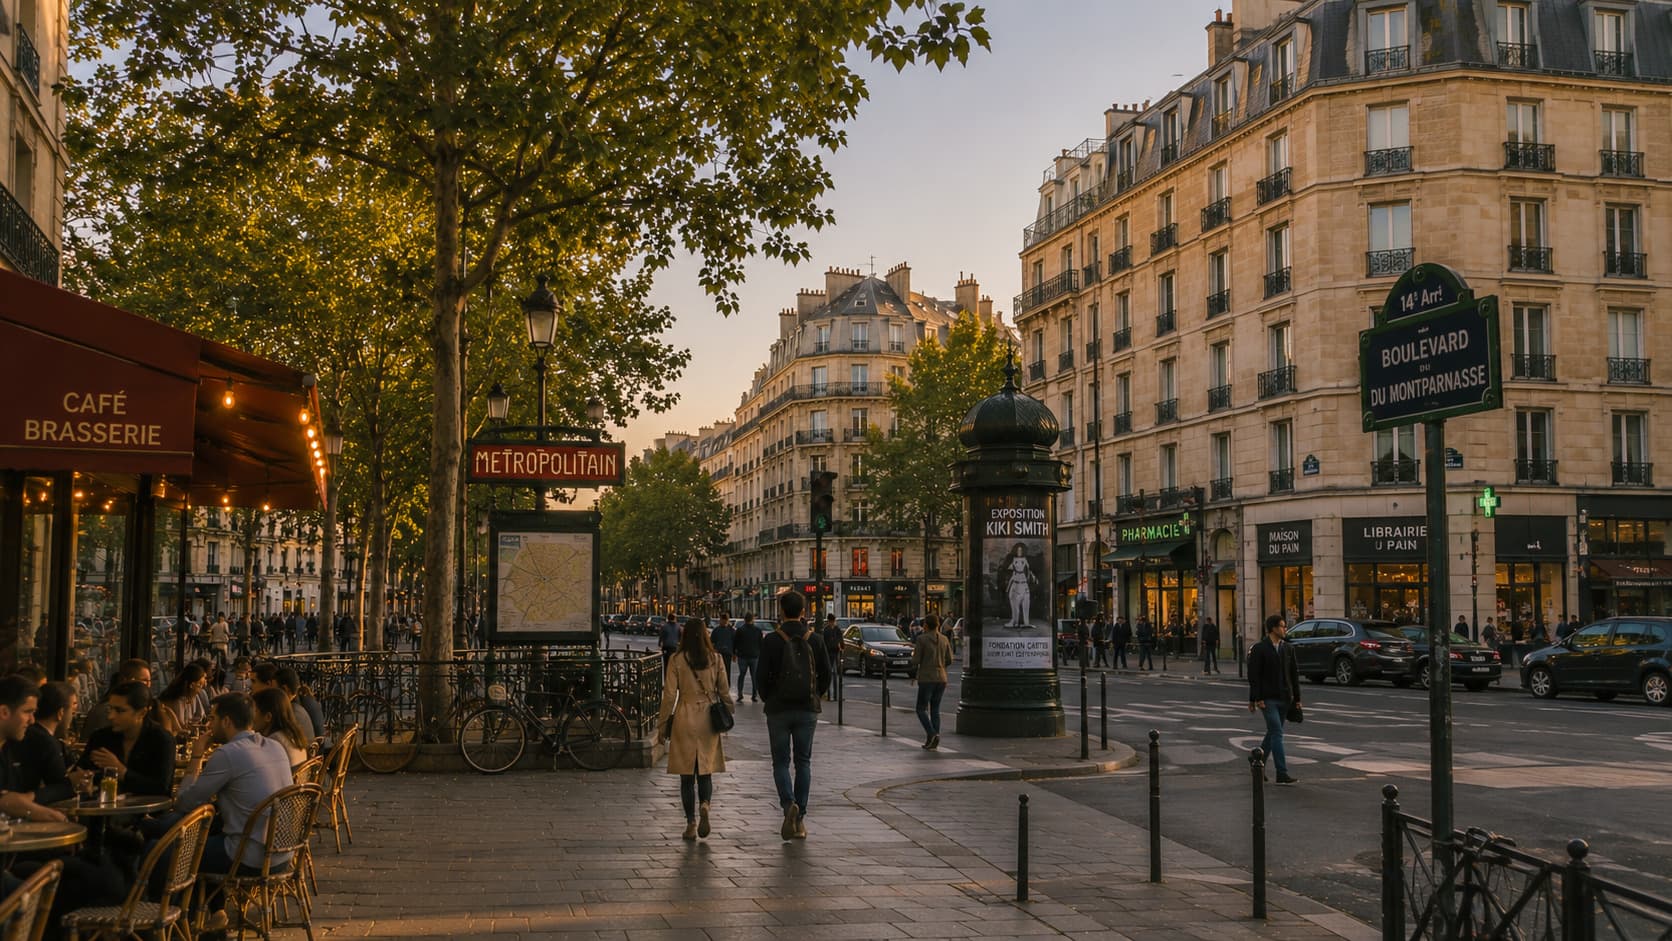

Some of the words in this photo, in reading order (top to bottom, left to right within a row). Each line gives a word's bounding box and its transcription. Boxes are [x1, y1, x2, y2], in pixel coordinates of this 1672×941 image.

[1381, 329, 1469, 368] BOULEVARD
[1371, 386, 1386, 407] DU
[1390, 365, 1486, 404] MONTPARNASSE
[63, 390, 127, 415] CAFÉ
[24, 419, 161, 445] BRASSERIE
[475, 449, 616, 476] METROPOLITAIN
[991, 508, 1045, 520] EXPOSITION
[986, 520, 1010, 536] KIKI
[1014, 520, 1049, 537] SMITH
[1121, 523, 1180, 542] PHARMACIE
[1268, 529, 1300, 543] MAISON
[1363, 526, 1428, 538] LIBRAIRIE
[1268, 543, 1280, 555] DU
[1281, 542, 1300, 554] PAIN
[1387, 539, 1417, 551] PAIN
